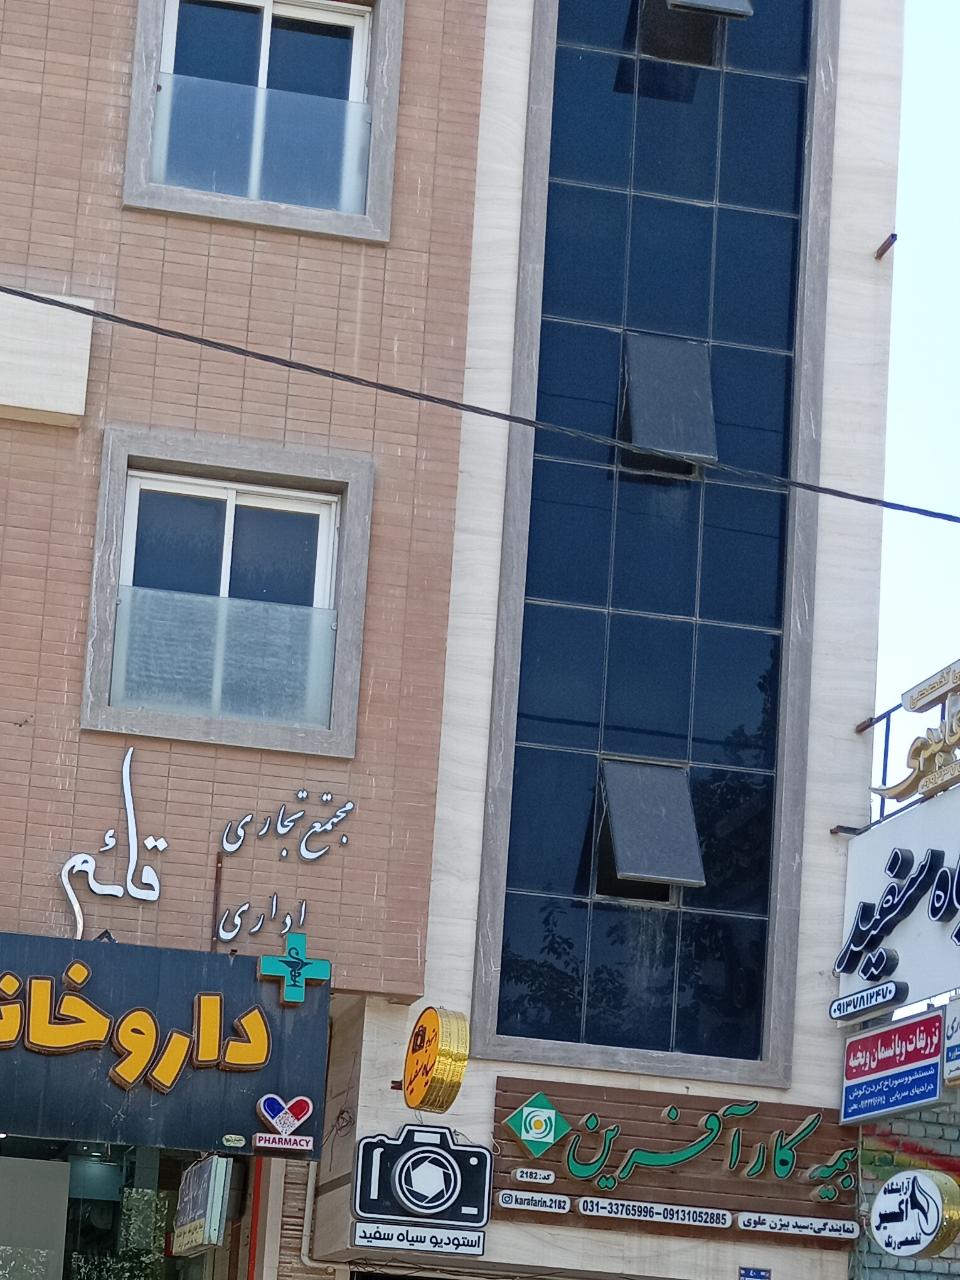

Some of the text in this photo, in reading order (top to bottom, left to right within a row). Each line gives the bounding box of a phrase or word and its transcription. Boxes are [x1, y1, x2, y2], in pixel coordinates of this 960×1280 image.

[61, 746, 169, 940] قائم
[221, 788, 356, 862] مجتمع تجاری
[217, 892, 308, 942] اداری
[257, 1135, 312, 1148] PHARMACY
[809, 1147, 858, 1201] بیمه
[359, 1226, 481, 1250] استودیو سیاه سفید
[742, 1215, 767, 1228] علوی
